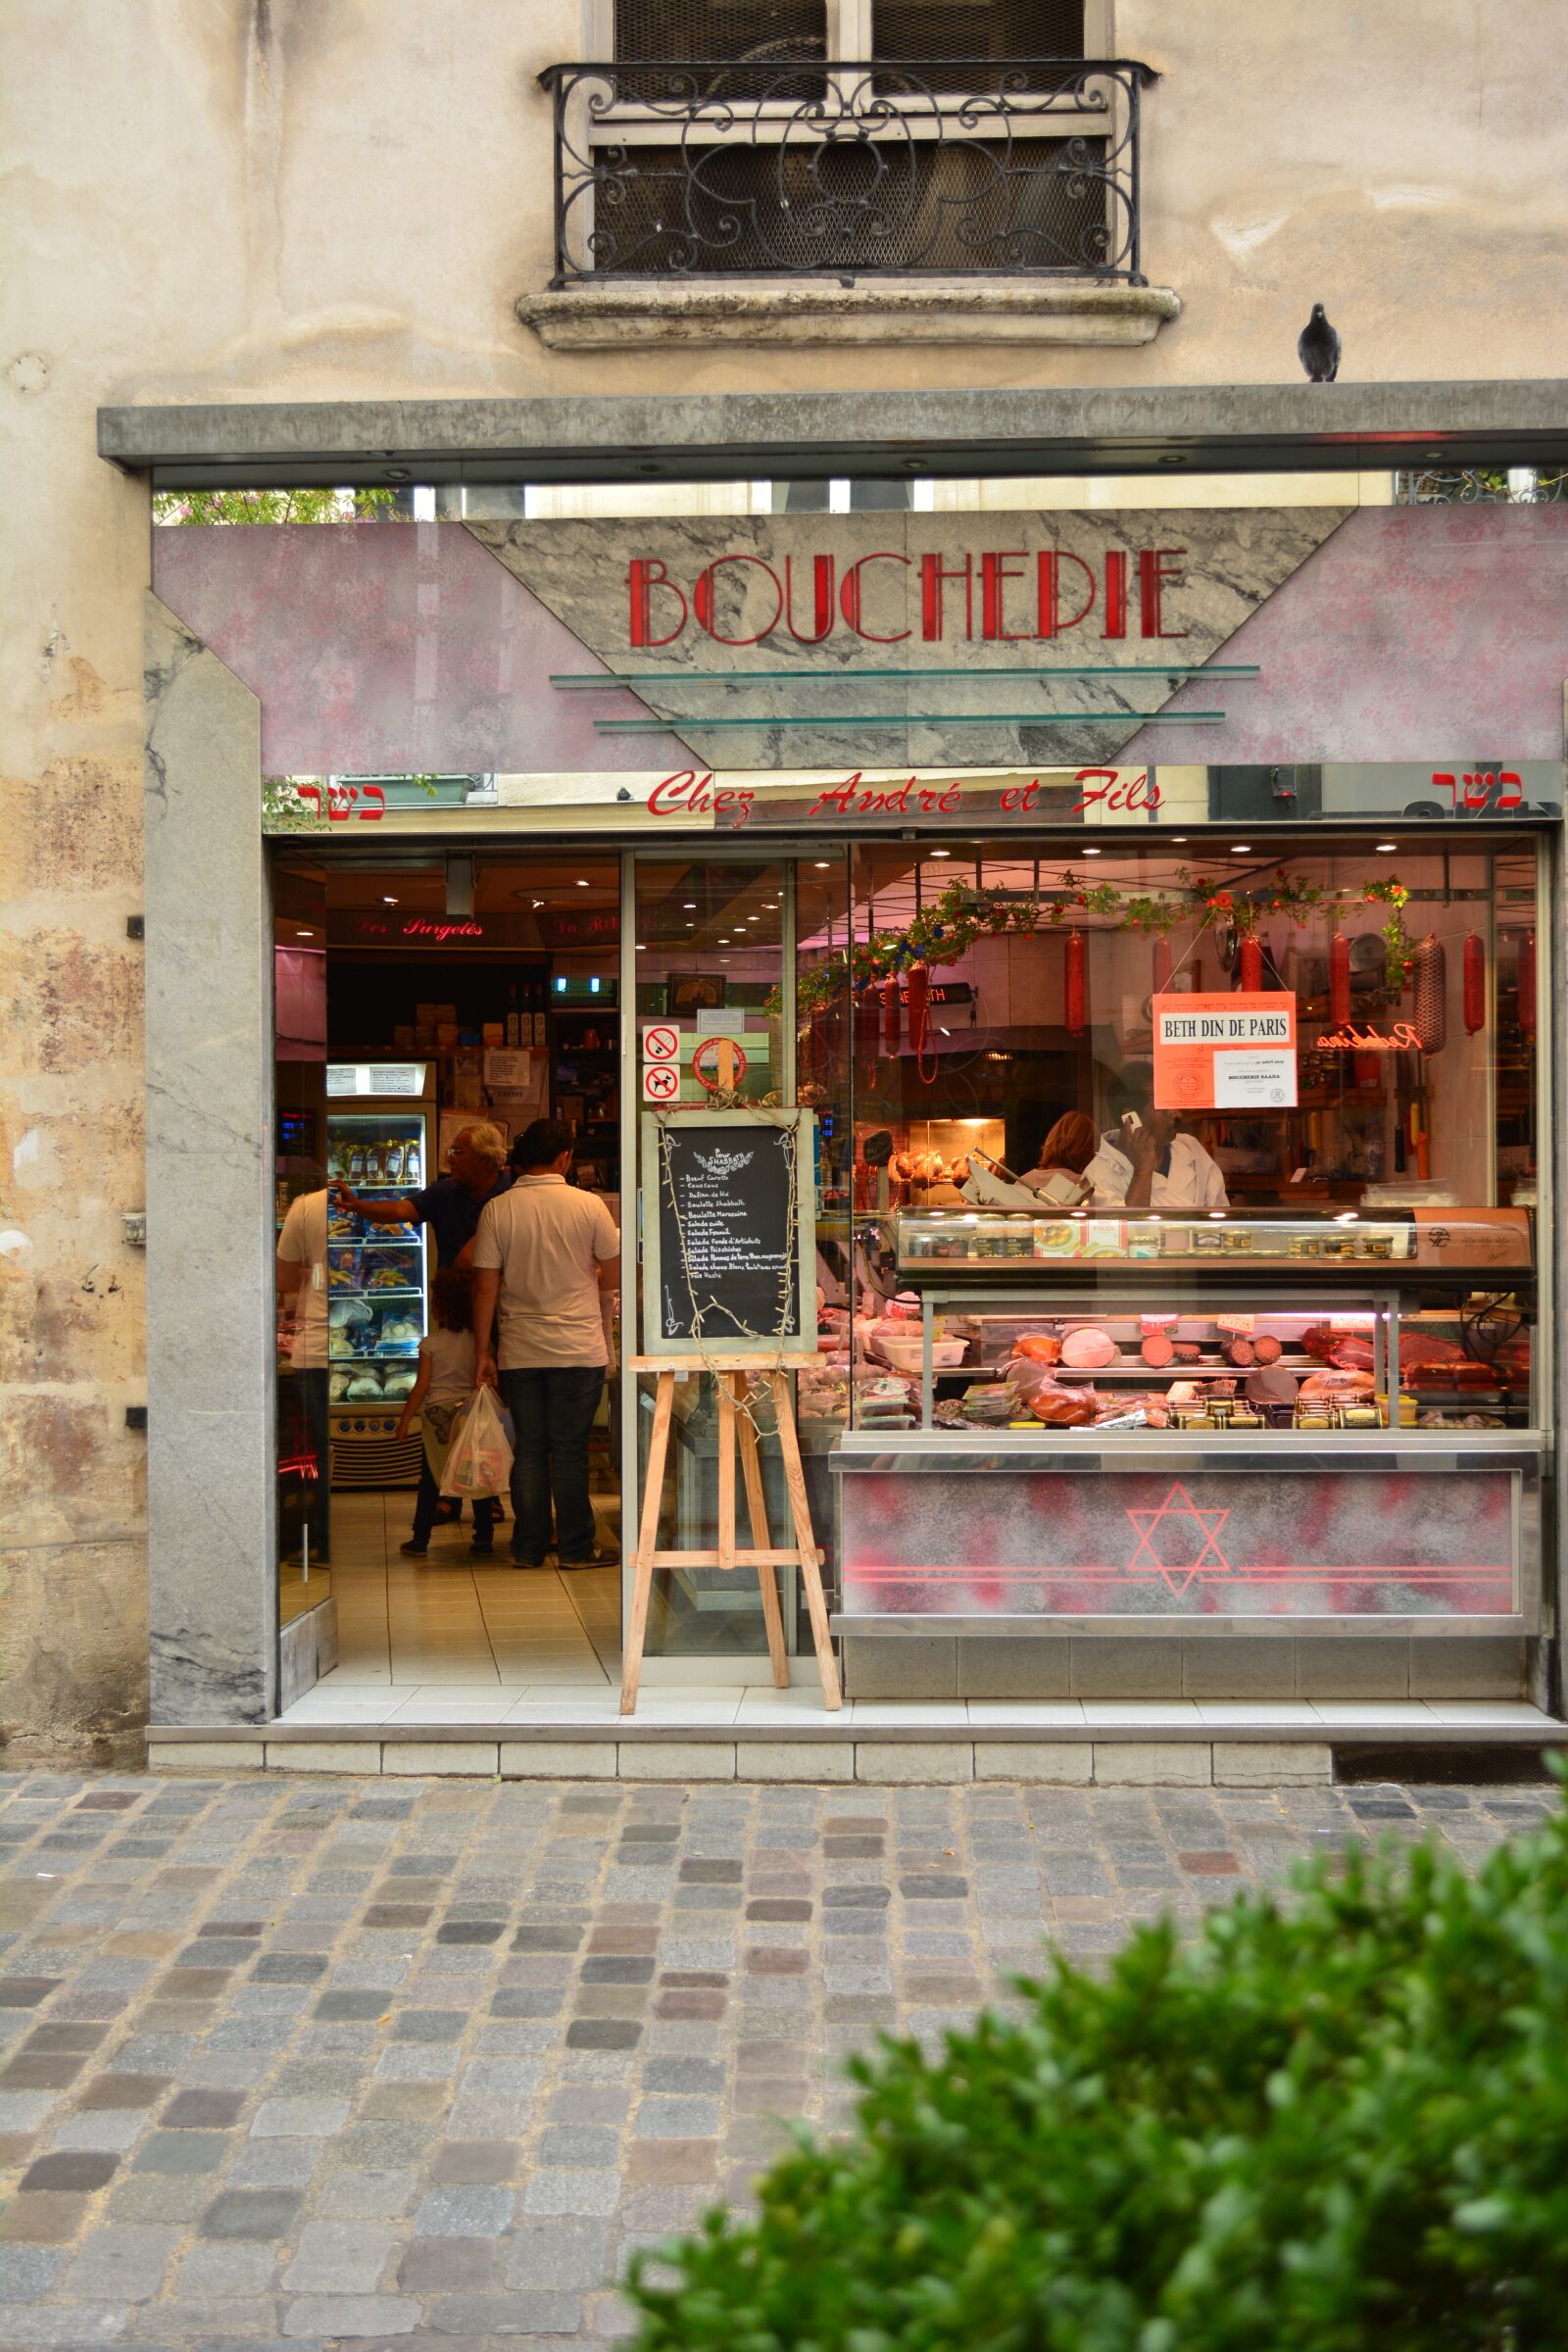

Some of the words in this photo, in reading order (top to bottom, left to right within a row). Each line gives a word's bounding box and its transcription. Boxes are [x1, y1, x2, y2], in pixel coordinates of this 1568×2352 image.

[297, 784, 385, 821] כשר
[647, 770, 755, 829] Chez
[808, 771, 962, 816] André
[1000, 778, 1041, 812] et
[1072, 769, 1166, 814] Fils
[1432, 771, 1522, 808] כשר
[1164, 1019, 1197, 1038] BETH
[1200, 1019, 1224, 1037] DIN
[1229, 1019, 1246, 1037] DE
[1250, 1018, 1287, 1036] PARIS
[714, 1148, 731, 1158] Pour
